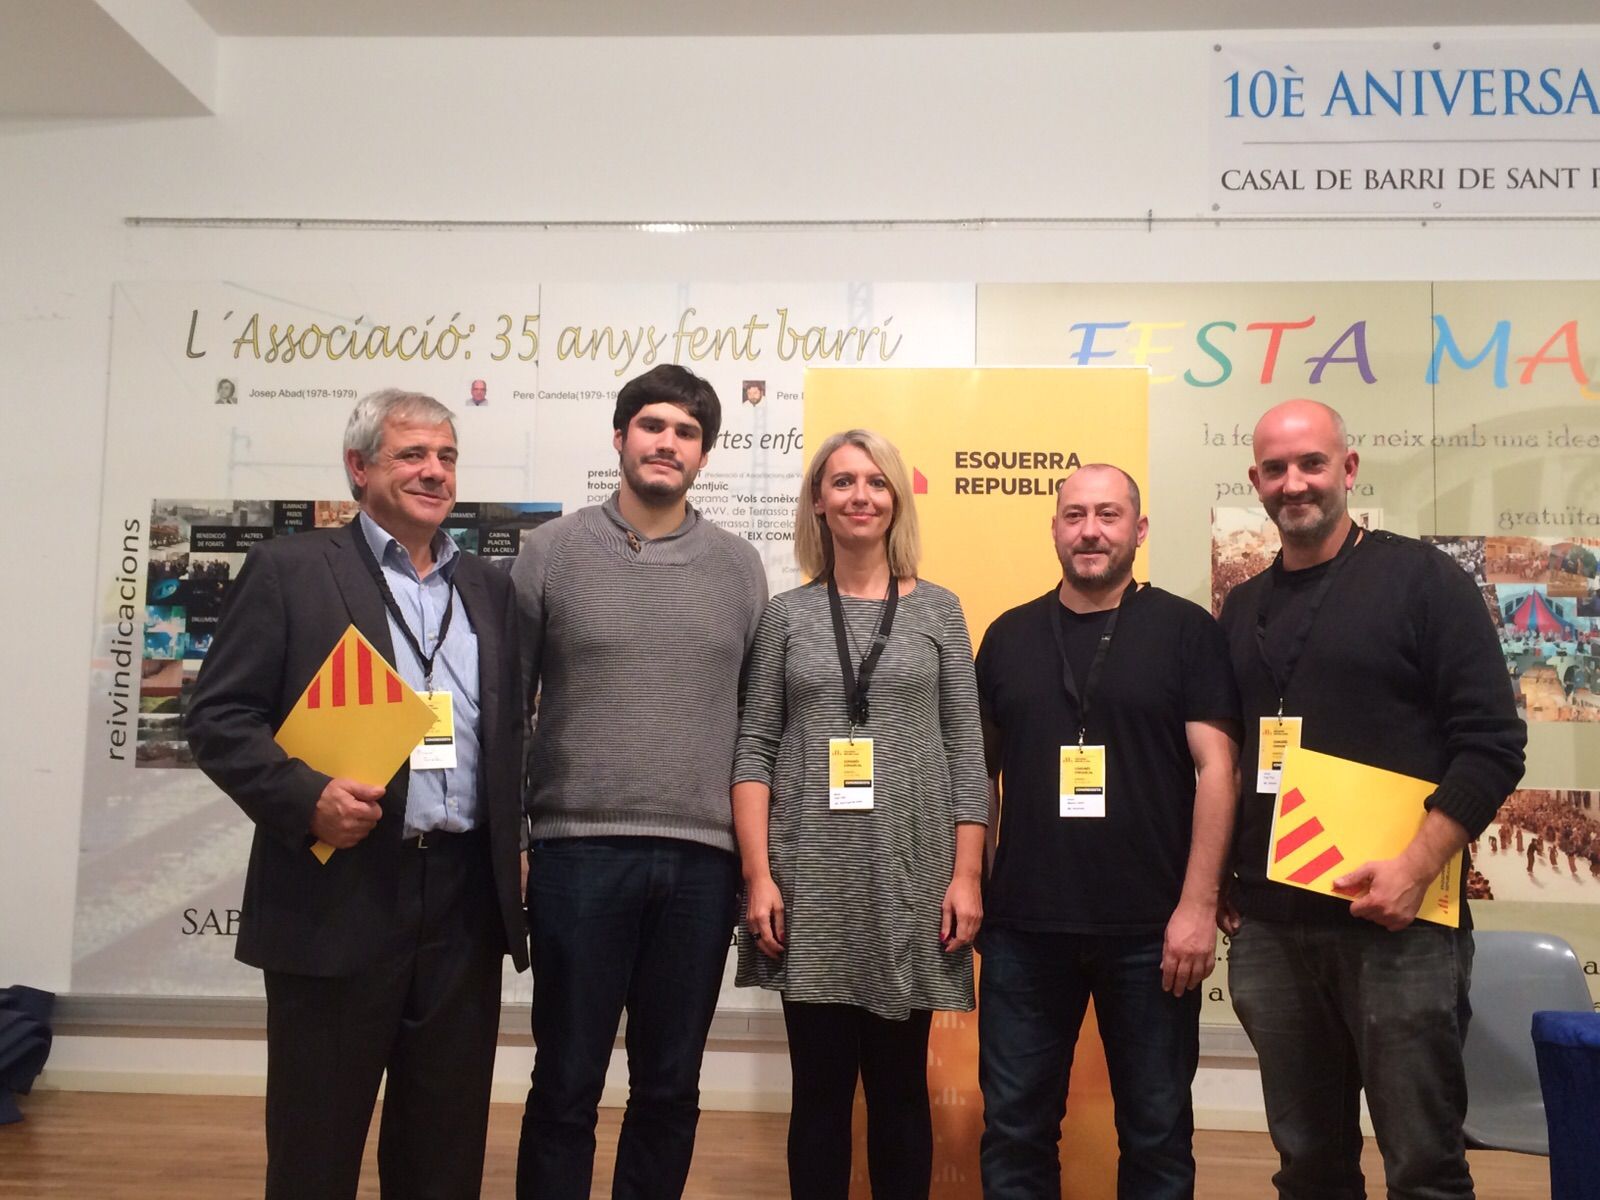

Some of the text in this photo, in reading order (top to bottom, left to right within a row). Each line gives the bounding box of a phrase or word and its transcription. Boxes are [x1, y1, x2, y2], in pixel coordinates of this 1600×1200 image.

[1223, 64, 1600, 118] 10È ANIVERSA
[1221, 168, 1305, 191] CASAL
[1316, 169, 1352, 190] DE
[1364, 168, 1444, 190] BARRI
[1458, 168, 1495, 189] DE
[1506, 167, 1580, 189] SANT
[491, 314, 540, 362] 35
[557, 324, 667, 376] anys
[672, 307, 769, 366] fent
[776, 308, 903, 361] barri
[1068, 314, 1600, 400] FESTA MA
[249, 388, 277, 399] Josep
[513, 390, 620, 401] Pere Candela(1979-19
[776, 391, 799, 401] Pere
[712, 427, 804, 455] rtes enfo
[1373, 430, 1424, 447] neix
[955, 451, 1082, 470] ESQUERRA
[587, 481, 621, 490] trobad
[955, 477, 1067, 496] REPUBLIC
[686, 495, 729, 504] ograma
[732, 507, 746, 516] de
[749, 507, 788, 516] Terrassa
[757, 519, 796, 528] Barcelo
[107, 518, 141, 761] reivindicacions
[182, 908, 241, 935] SAB
